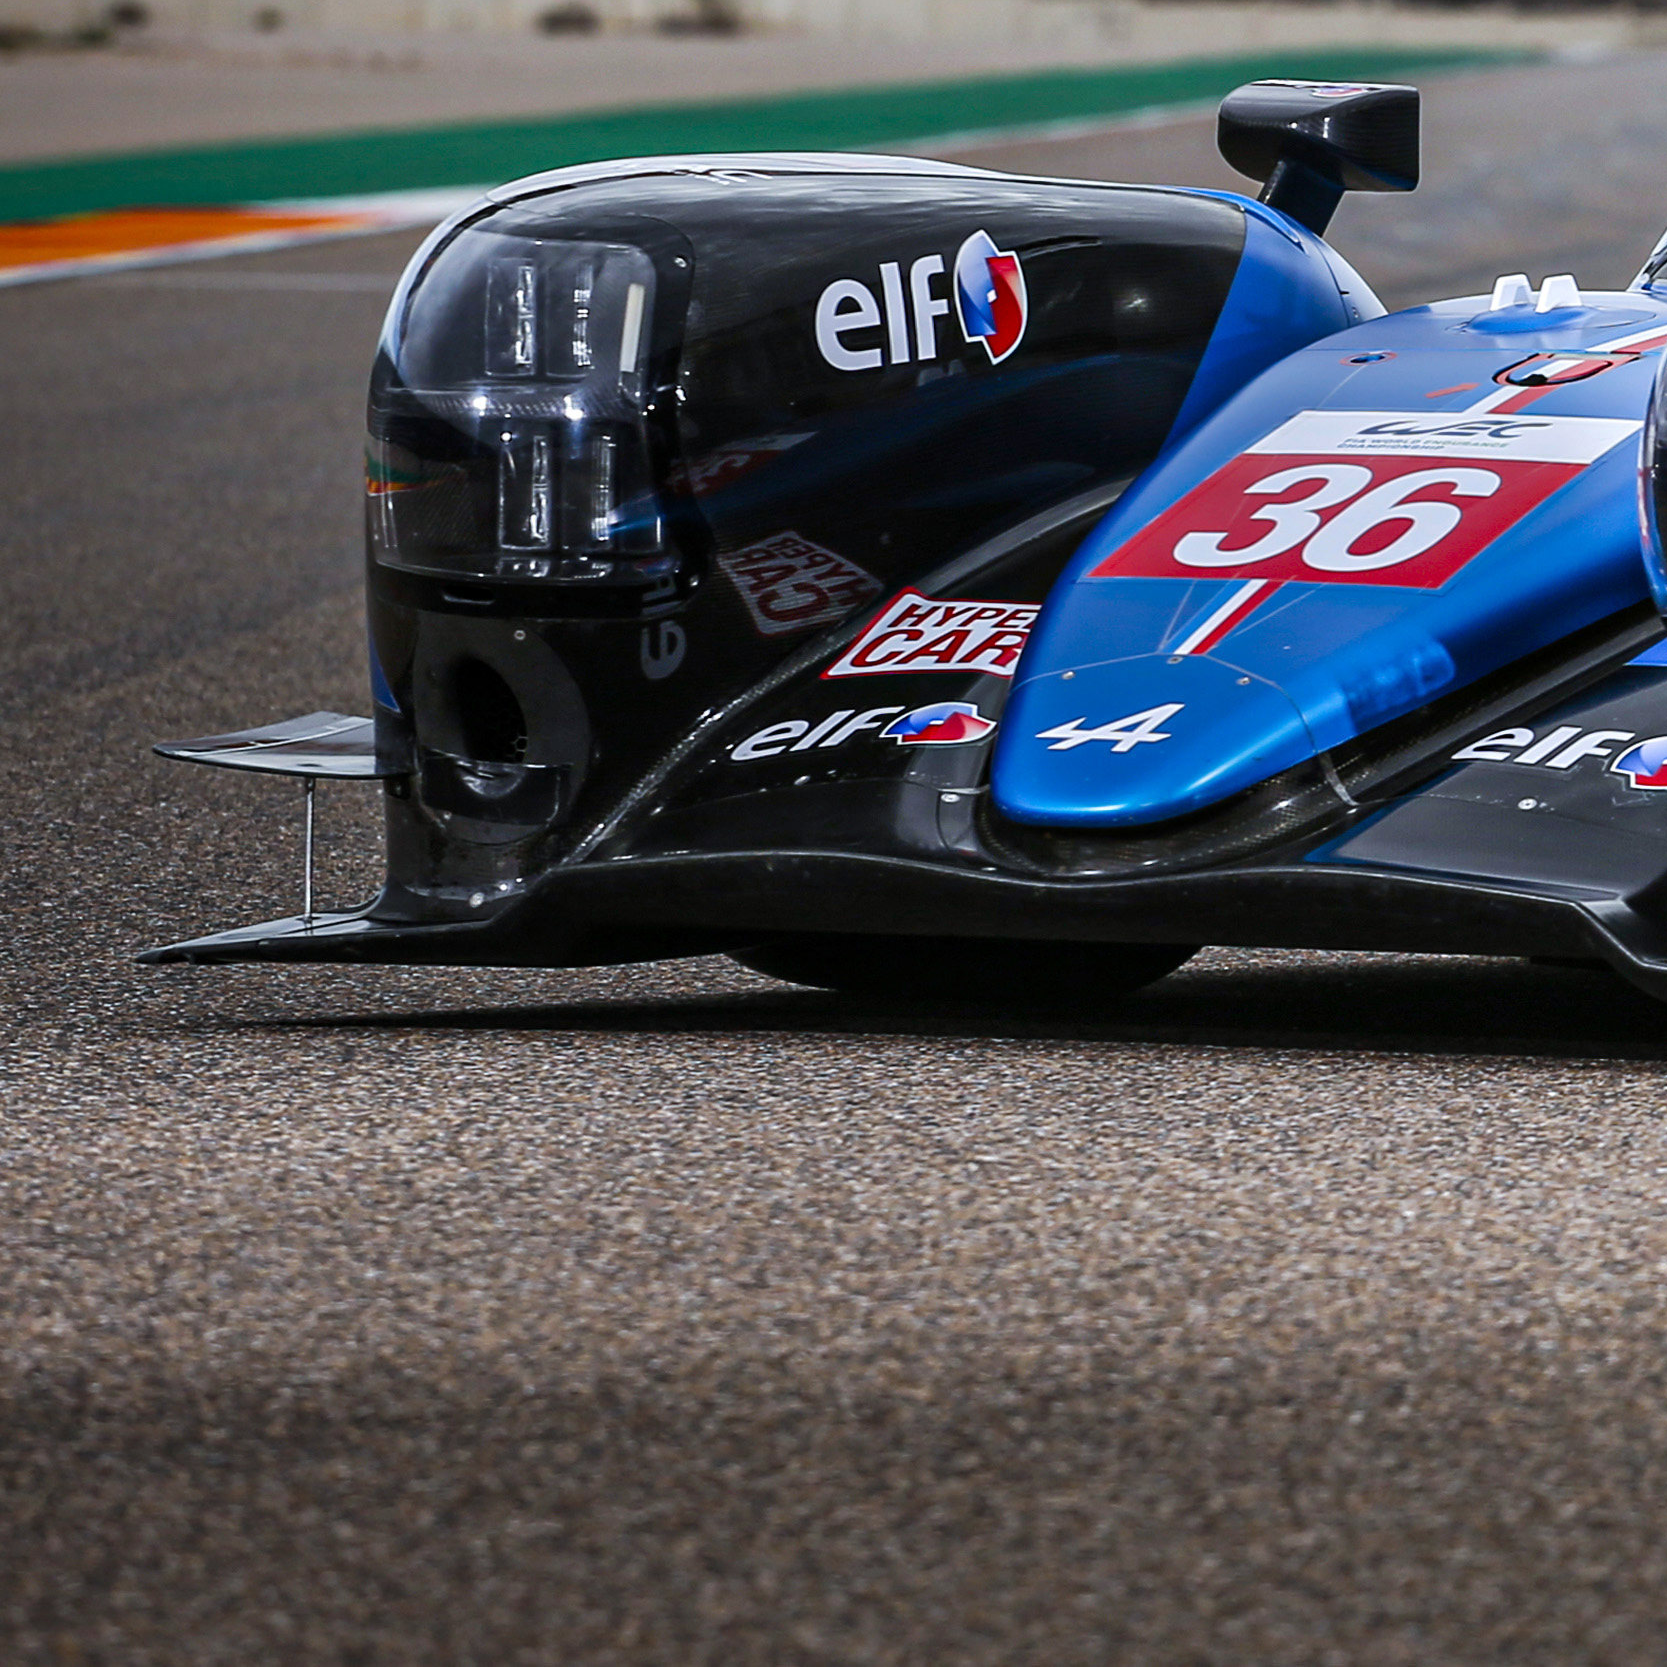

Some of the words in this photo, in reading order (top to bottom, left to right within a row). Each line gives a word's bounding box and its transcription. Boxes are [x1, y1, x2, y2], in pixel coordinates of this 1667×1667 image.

[816, 255, 950, 371] elf
[1173, 464, 1502, 572] 36
[887, 603, 1043, 628] HYPE
[729, 705, 905, 761] elf
[1452, 727, 1636, 769] elf
